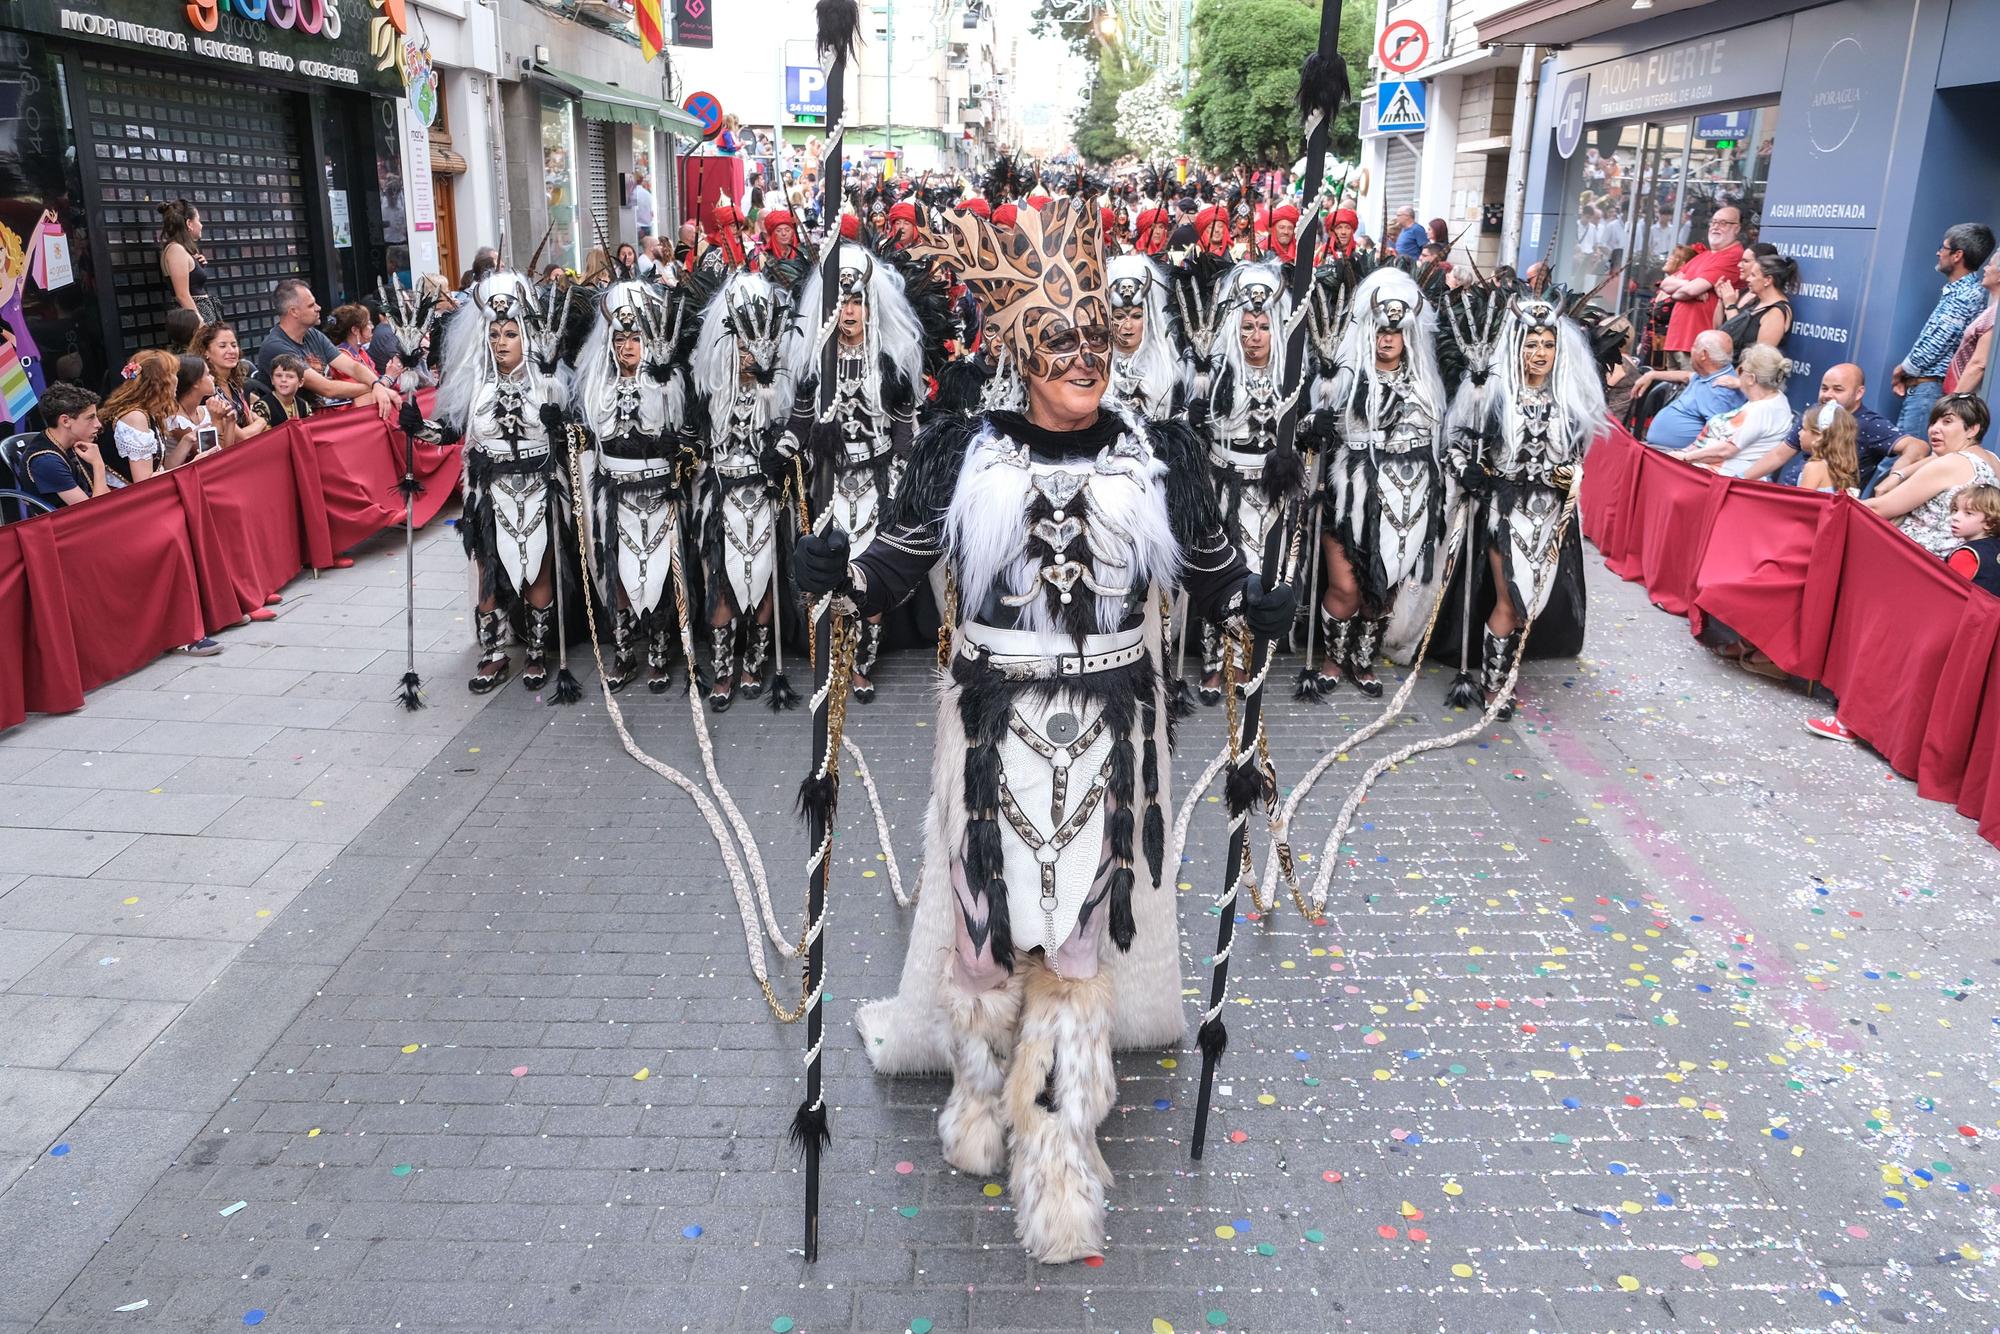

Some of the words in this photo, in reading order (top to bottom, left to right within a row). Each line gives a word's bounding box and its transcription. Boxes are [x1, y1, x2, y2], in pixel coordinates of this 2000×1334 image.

[61, 9, 119, 38] MODA
[118, 21, 188, 52] INTERIOR
[194, 37, 253, 64] LENCERIA
[258, 50, 295, 72] BAÑO
[299, 60, 358, 84] CORSETERIA
[1600, 62, 1640, 97] AQUA
[1645, 39, 1726, 88] FUERTE
[799, 68, 825, 103] P
[1811, 87, 1860, 107] APORAGUA
[789, 103, 801, 112] 24
[802, 104, 827, 113] HORA
[1600, 98, 1643, 115] TRATAMIENTO
[1691, 84, 1713, 101] AGUA
[1559, 91, 1582, 139] AF
[1770, 204, 1796, 218] AGUA
[1795, 204, 1866, 219] HIDROGENADA
[1789, 243, 1835, 260] ALCALINA
[1798, 282, 1839, 301] INVERSA
